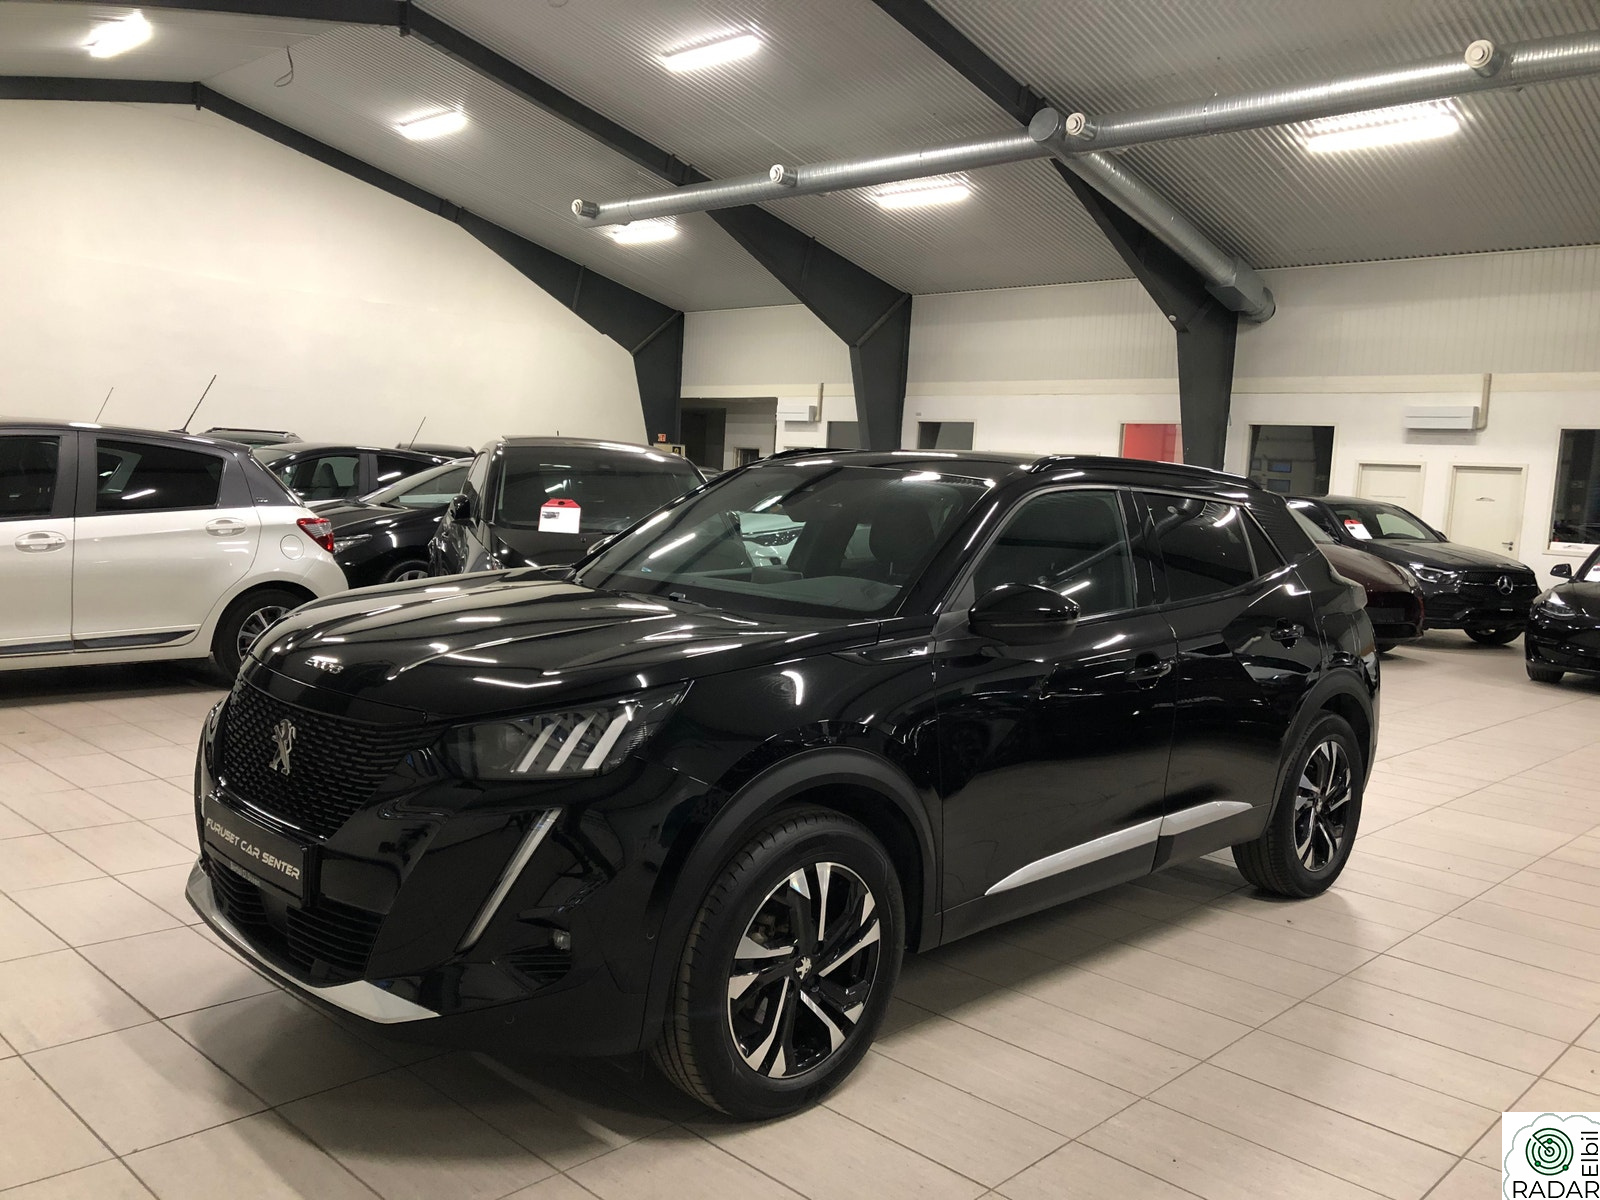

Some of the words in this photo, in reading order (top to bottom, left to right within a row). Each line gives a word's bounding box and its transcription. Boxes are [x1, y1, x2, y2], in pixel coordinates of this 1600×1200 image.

[206, 817, 240, 846] FURUSET
[240, 840, 260, 859] CAR
[261, 852, 300, 880] SENTER
